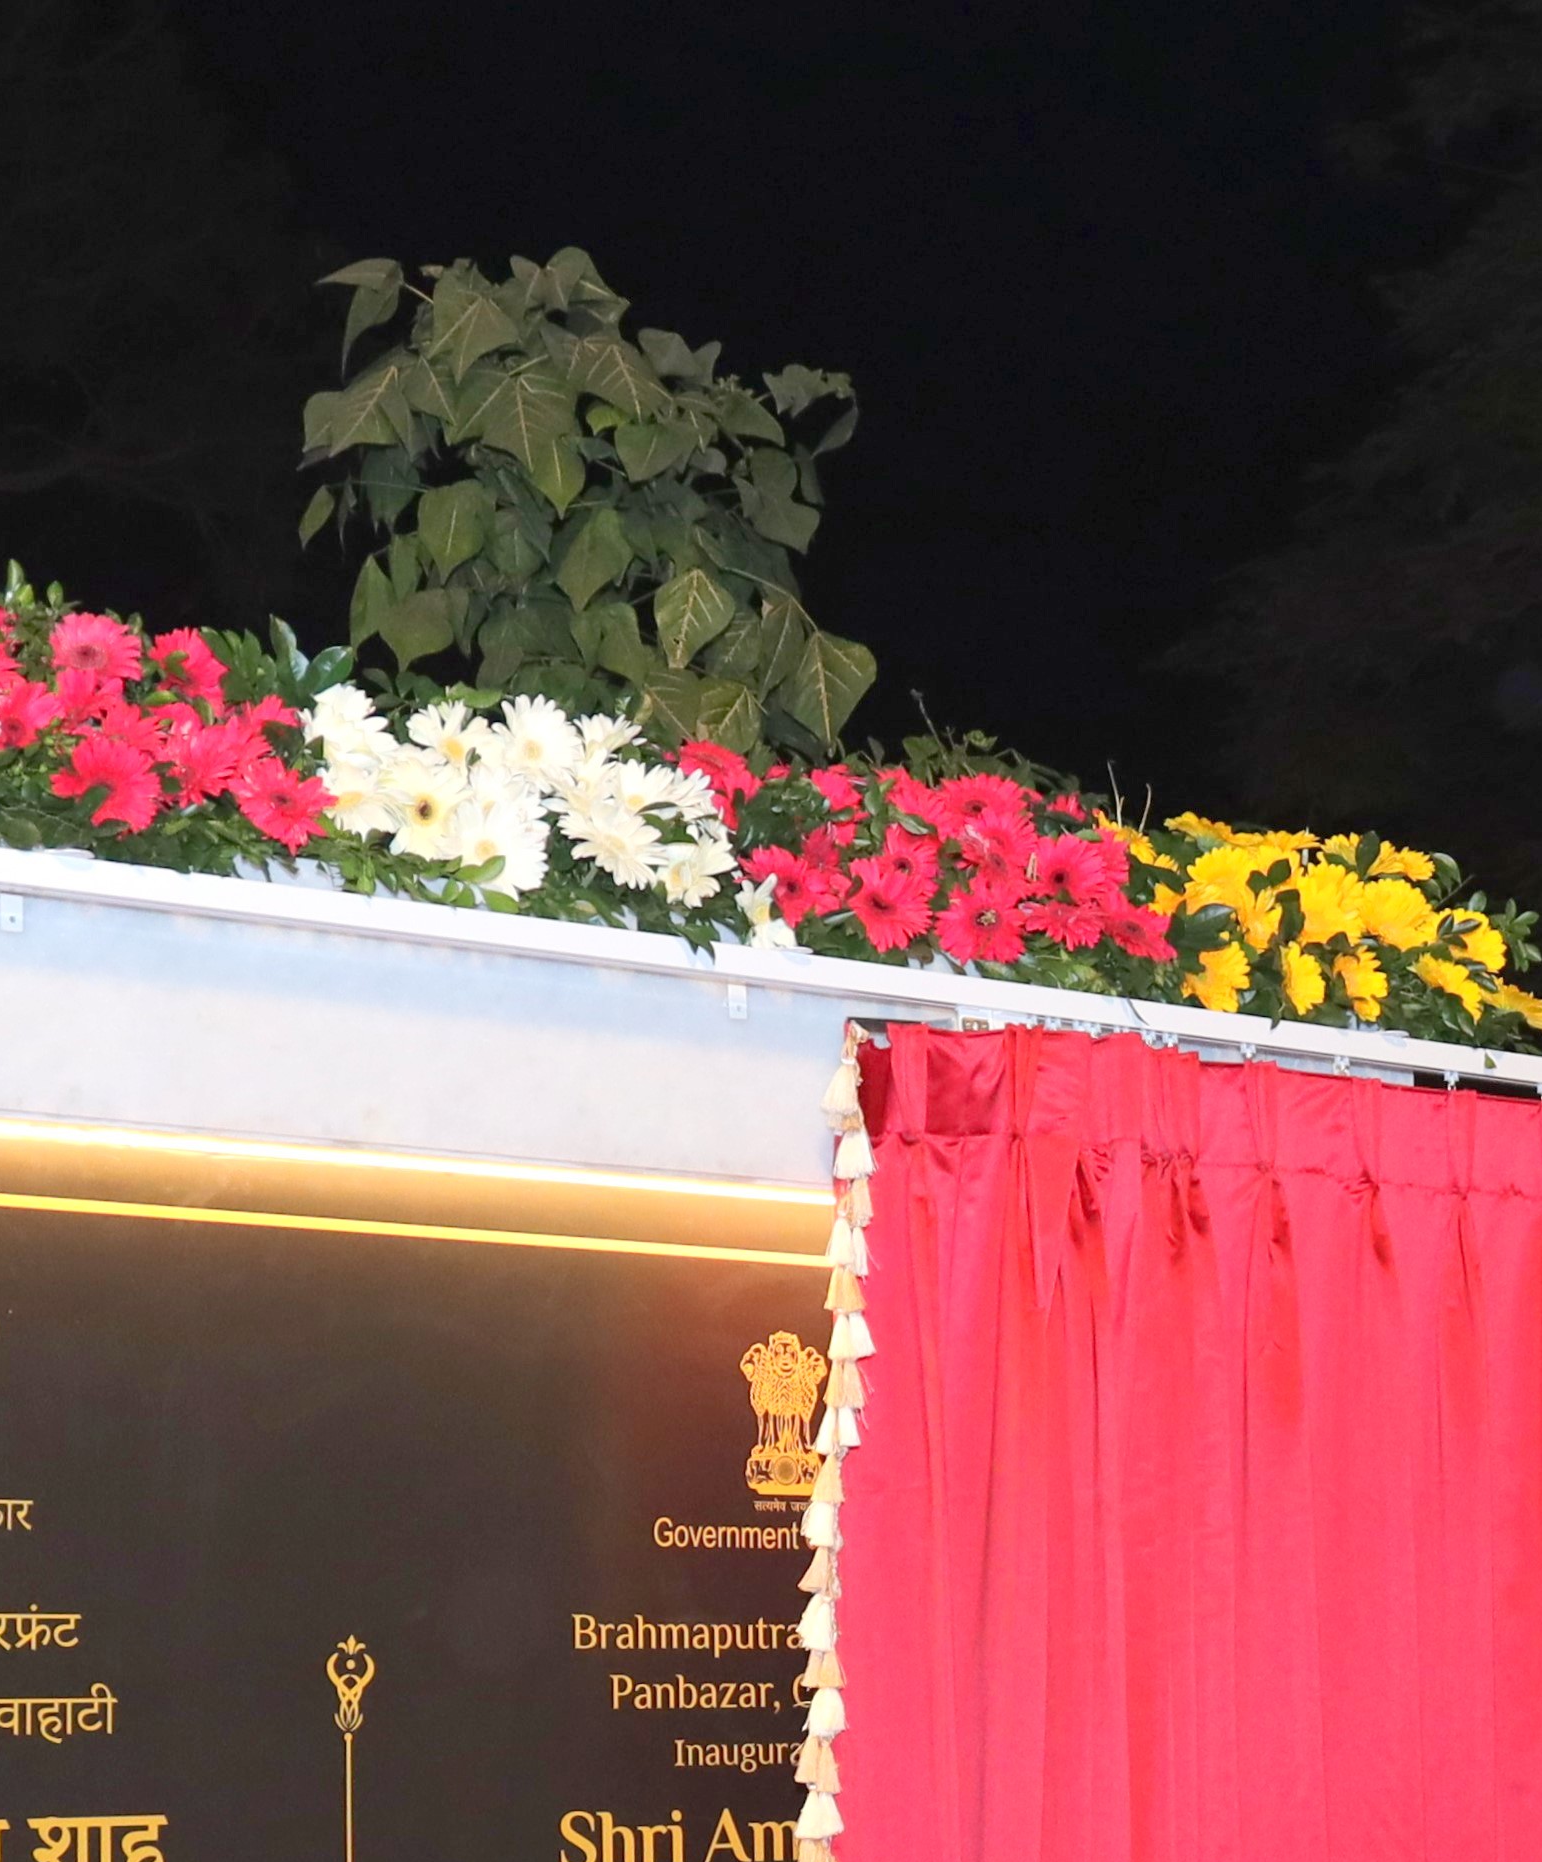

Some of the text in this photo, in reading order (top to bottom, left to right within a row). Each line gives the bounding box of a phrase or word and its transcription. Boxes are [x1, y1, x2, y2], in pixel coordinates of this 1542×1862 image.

[653, 1517, 800, 1552] Government
[572, 1613, 804, 1660] Brahmaputra
[608, 1673, 782, 1714] Panbazar,
[674, 1737, 802, 1773] Inaugura
